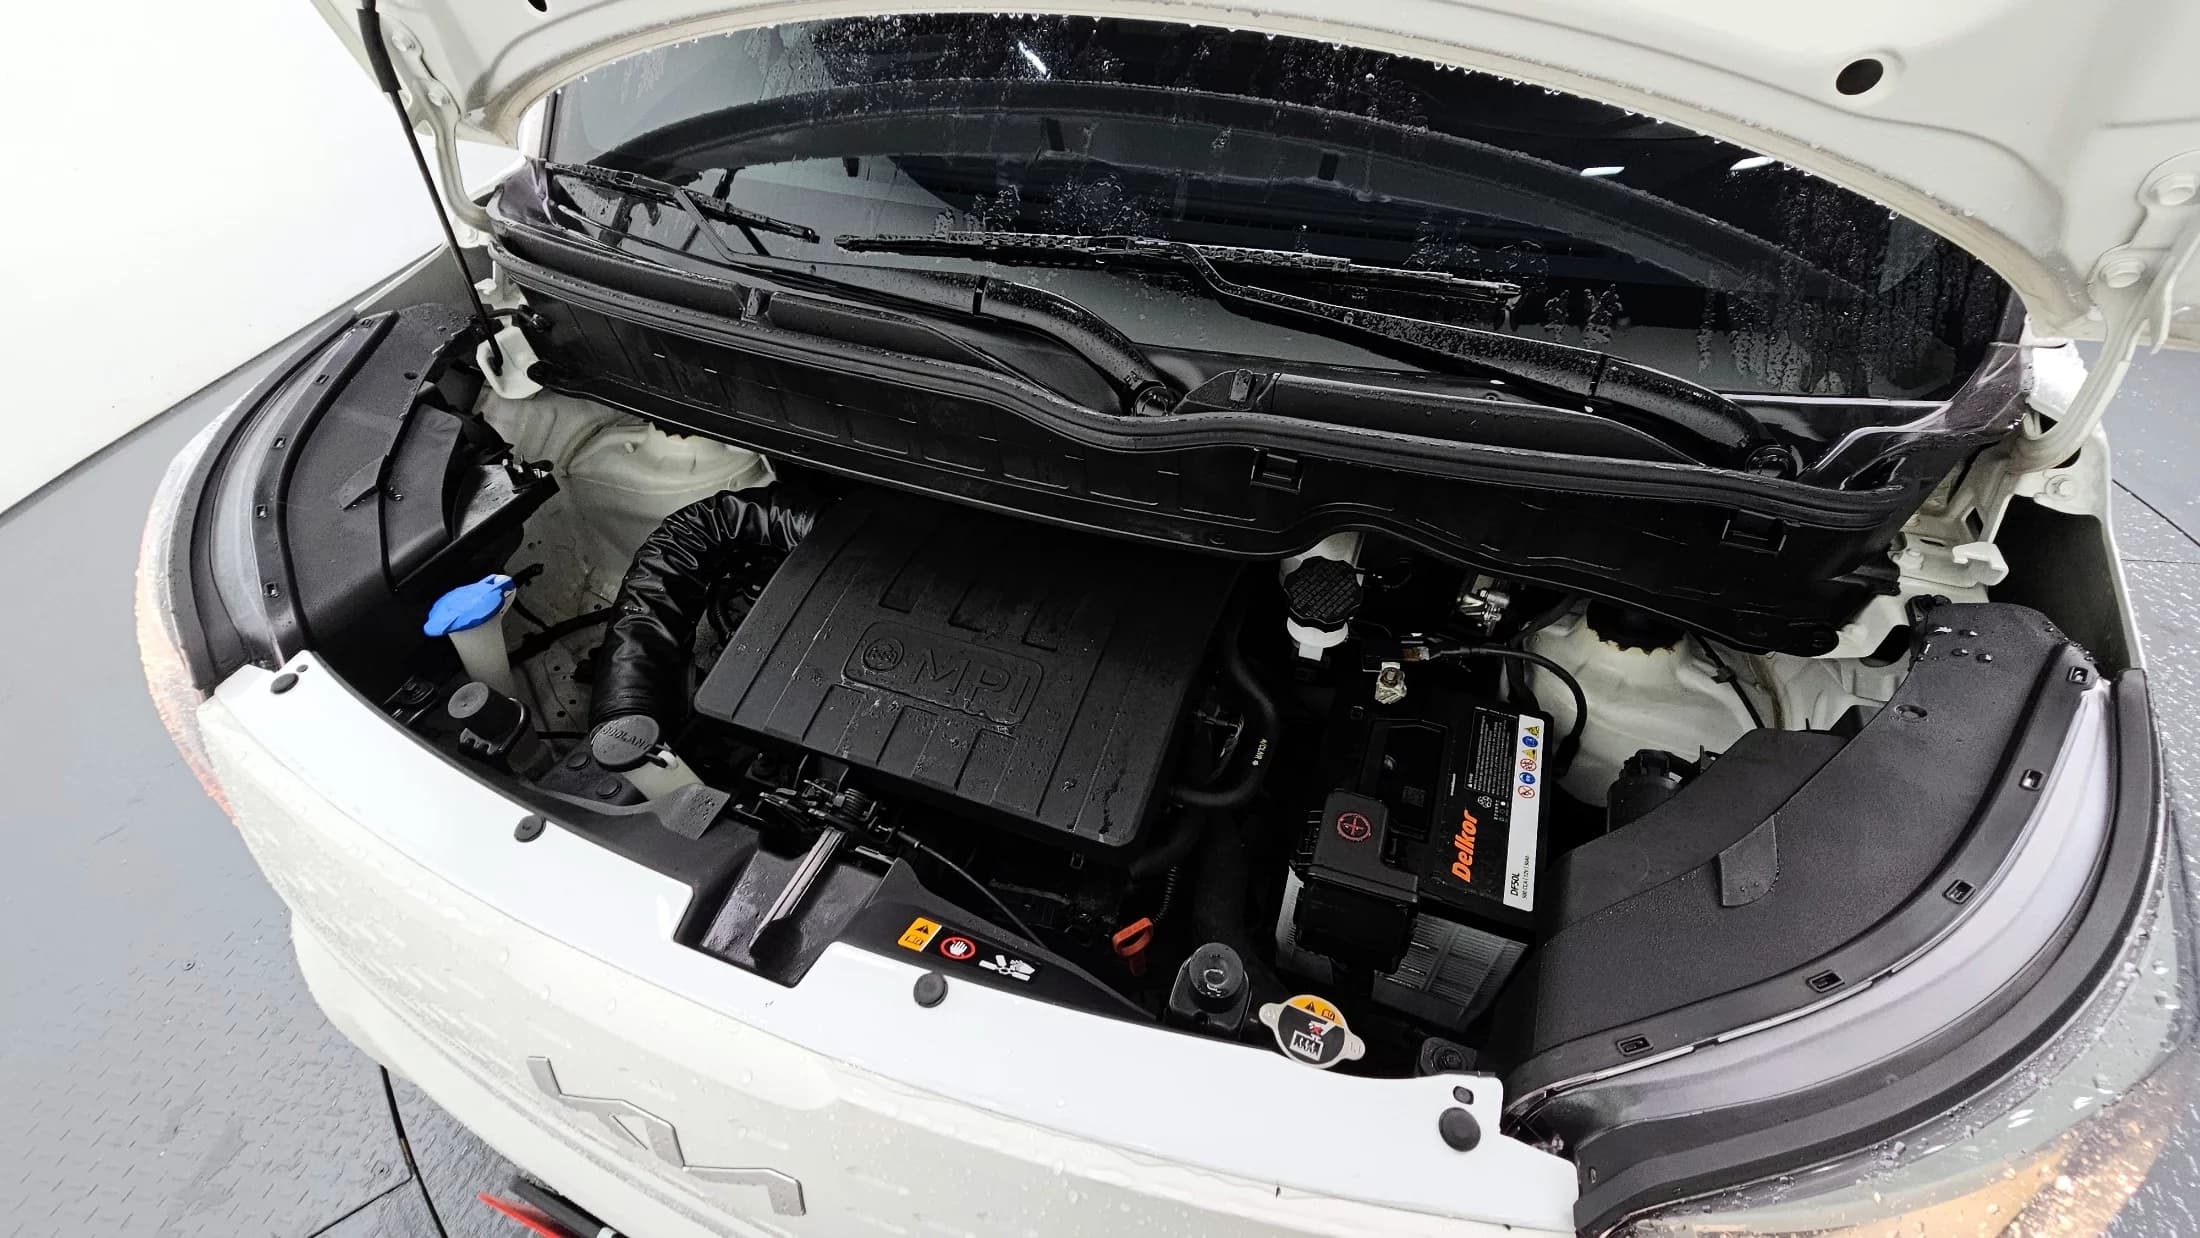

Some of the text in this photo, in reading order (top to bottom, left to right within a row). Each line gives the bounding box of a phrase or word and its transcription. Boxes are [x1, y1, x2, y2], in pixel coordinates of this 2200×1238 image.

[911, 648, 1033, 715] MPI
[1451, 808, 1478, 883] Delkor
[1510, 873, 1520, 897] DF50L
